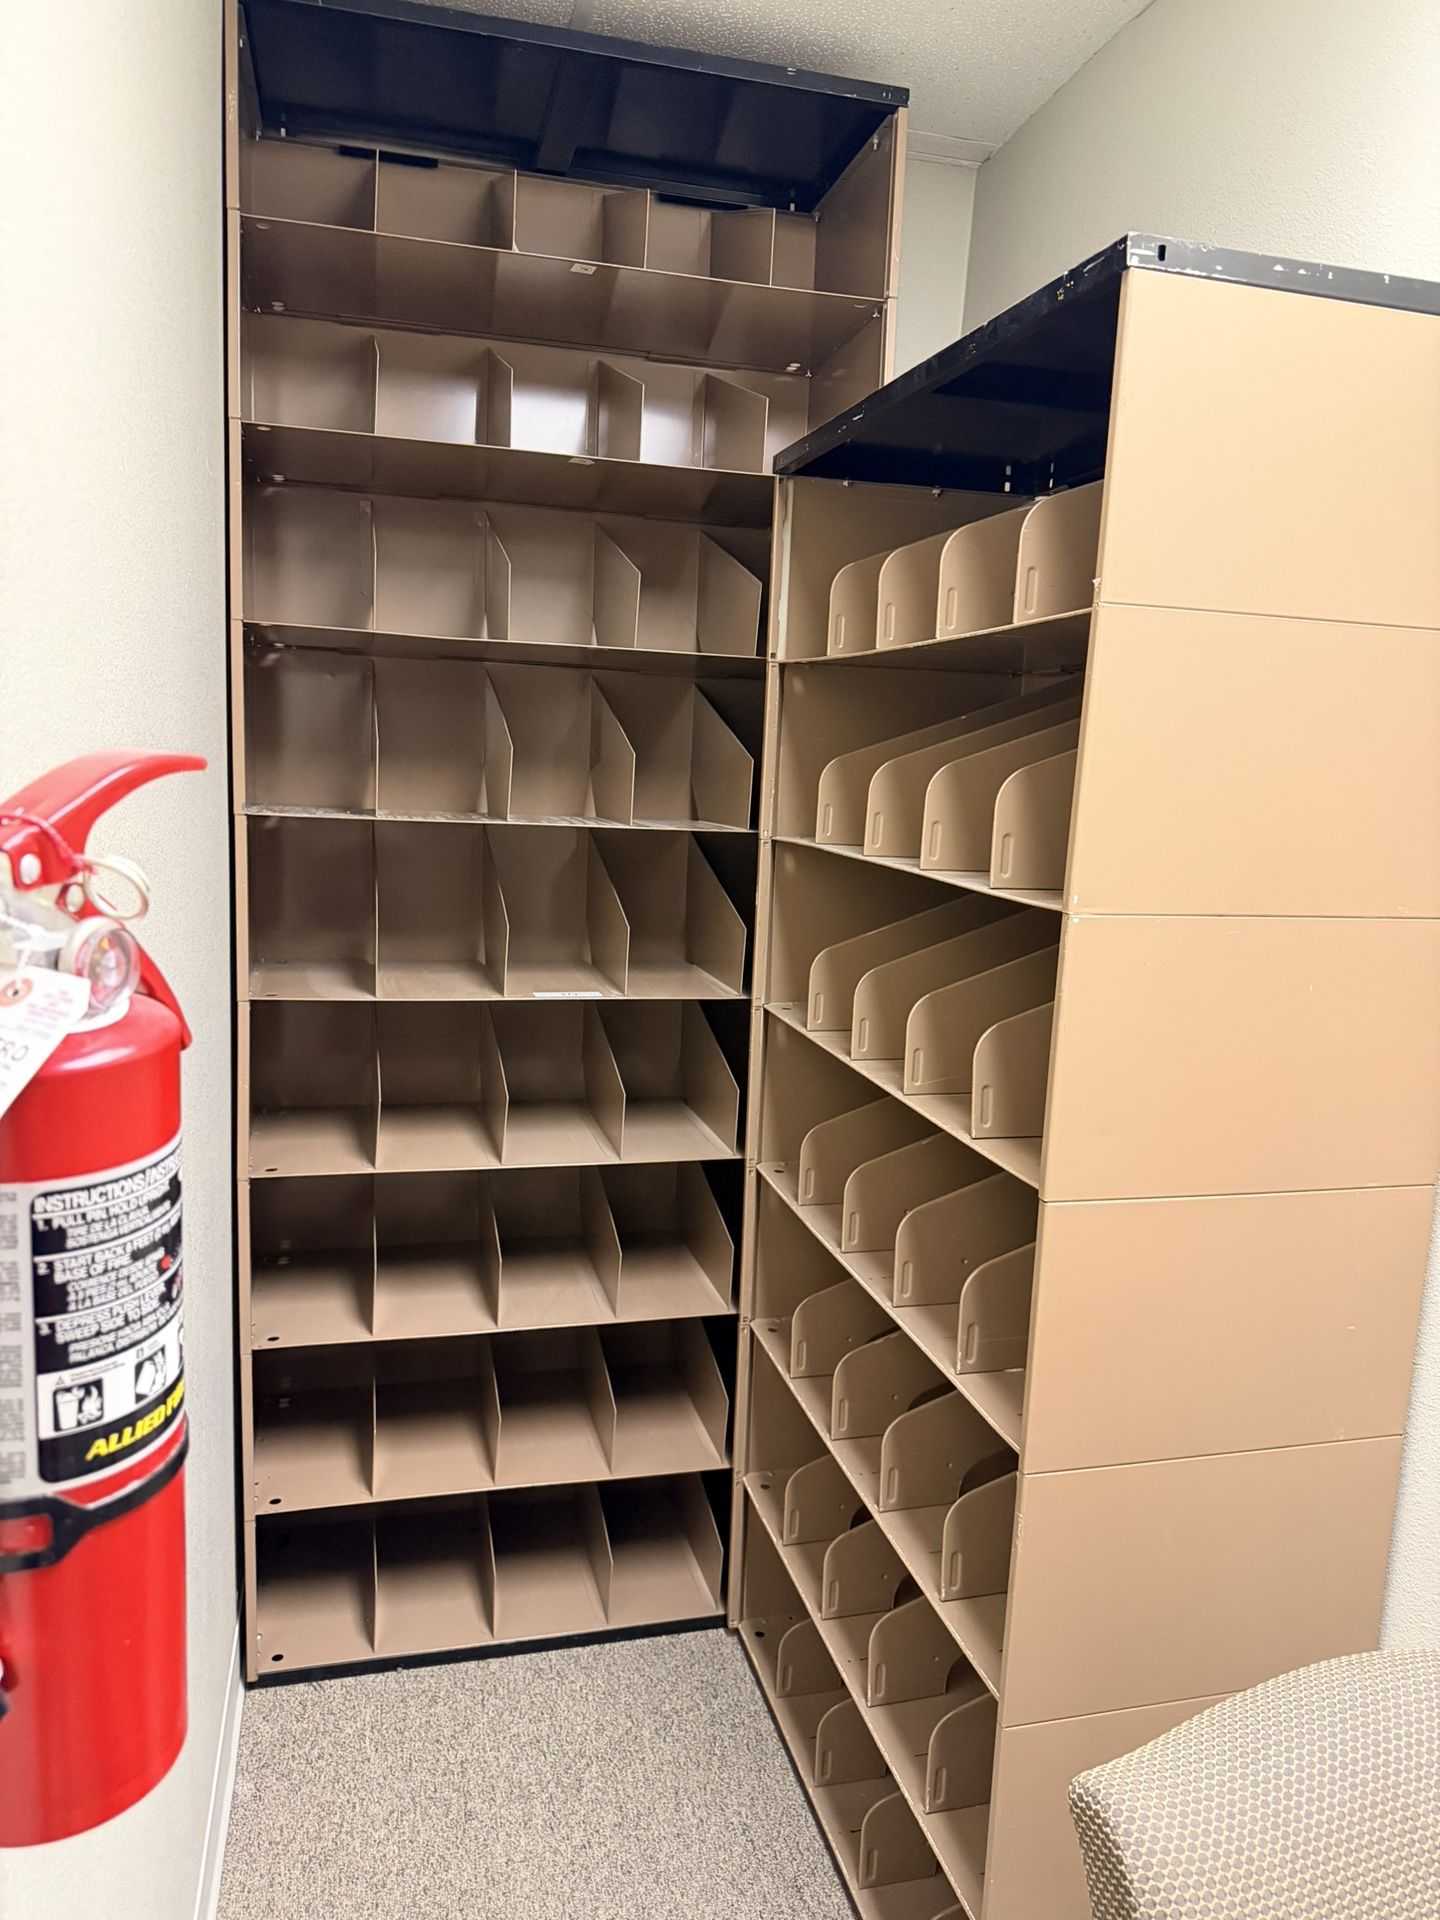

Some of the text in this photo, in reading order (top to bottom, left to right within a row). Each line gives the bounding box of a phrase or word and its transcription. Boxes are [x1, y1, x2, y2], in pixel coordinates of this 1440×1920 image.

[54, 1254, 92, 1273] START
[54, 1266, 88, 1286] BASE
[89, 1261, 106, 1277] OF
[127, 1305, 140, 1321] TO
[85, 1404, 166, 1461] ALLIED
